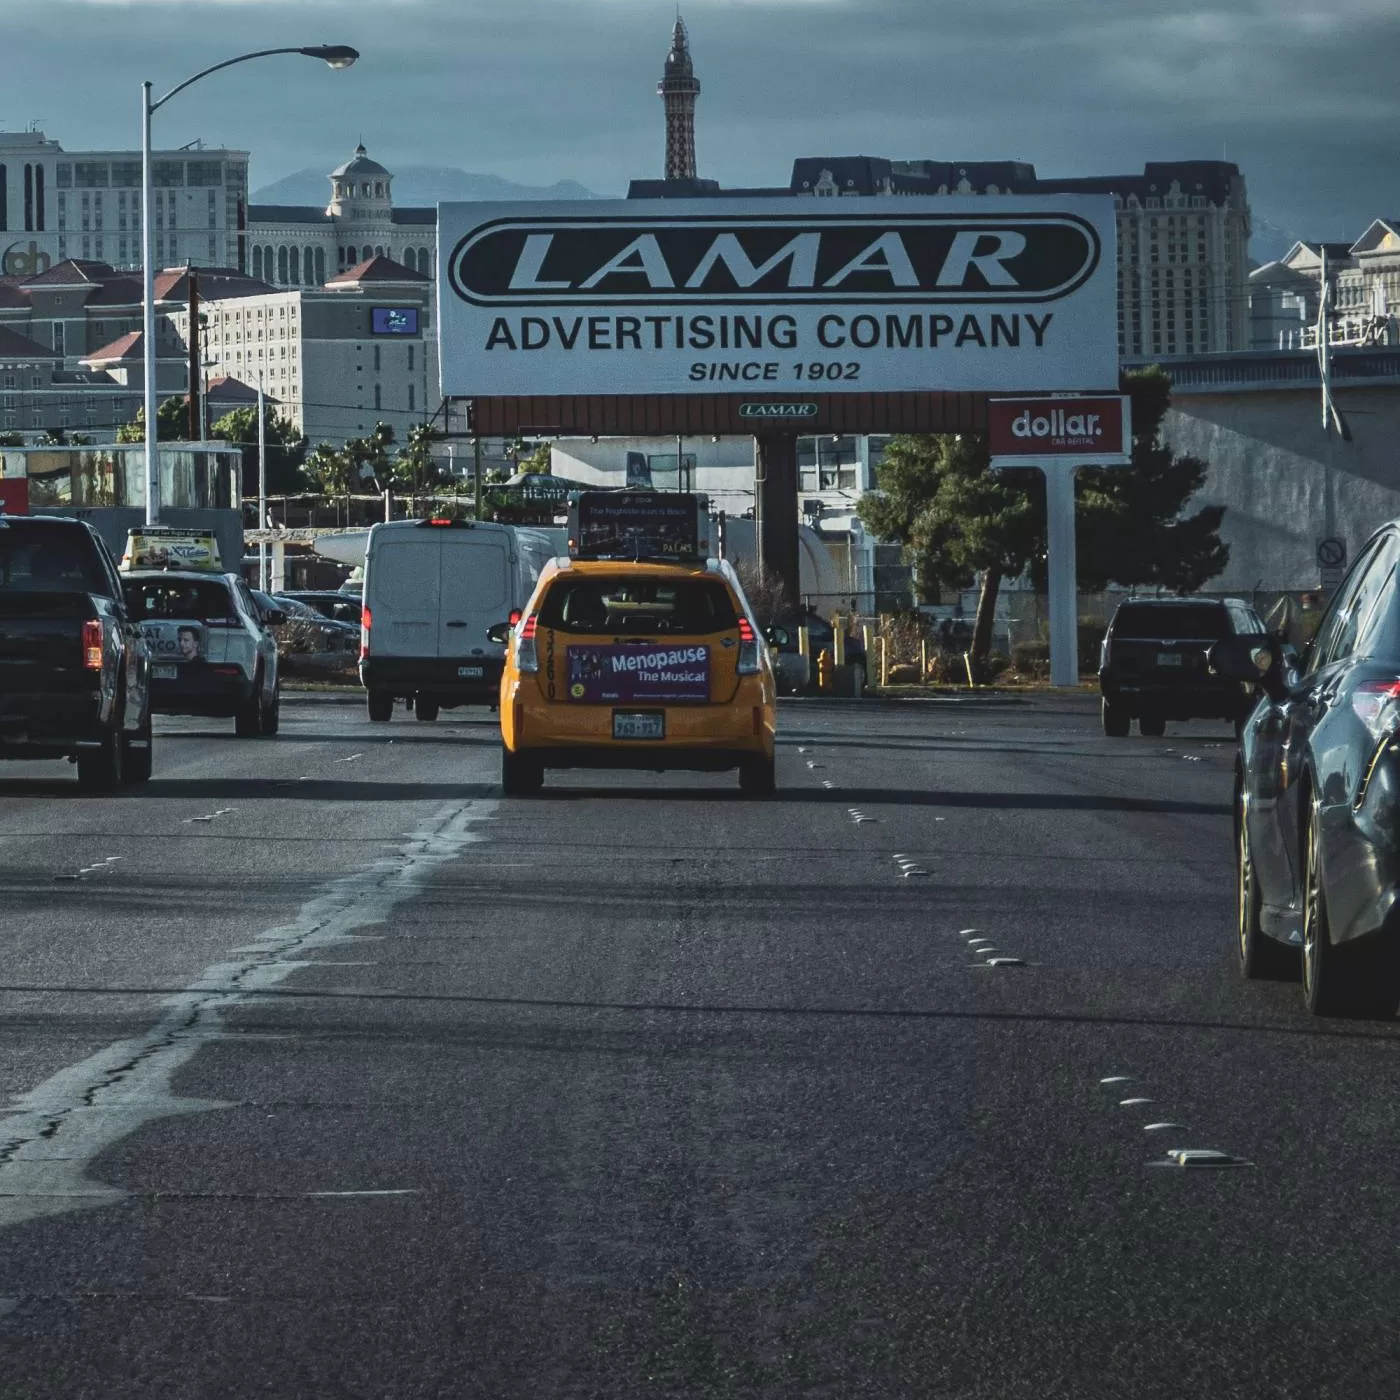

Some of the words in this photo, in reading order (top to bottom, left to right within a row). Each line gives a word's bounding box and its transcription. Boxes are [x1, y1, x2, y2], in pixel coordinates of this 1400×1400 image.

[508, 230, 1027, 290] LAMAR
[485, 314, 798, 351] ADVERTISING
[816, 312, 1054, 349] COMPANY
[688, 362, 779, 381] SINCE
[792, 361, 861, 381] 1902
[746, 405, 809, 415] LAMAR
[1012, 408, 1102, 437] dollar.
[663, 543, 693, 553] PALMS
[611, 647, 707, 673] Menopause
[638, 671, 659, 682] The
[660, 670, 706, 682] Musical
